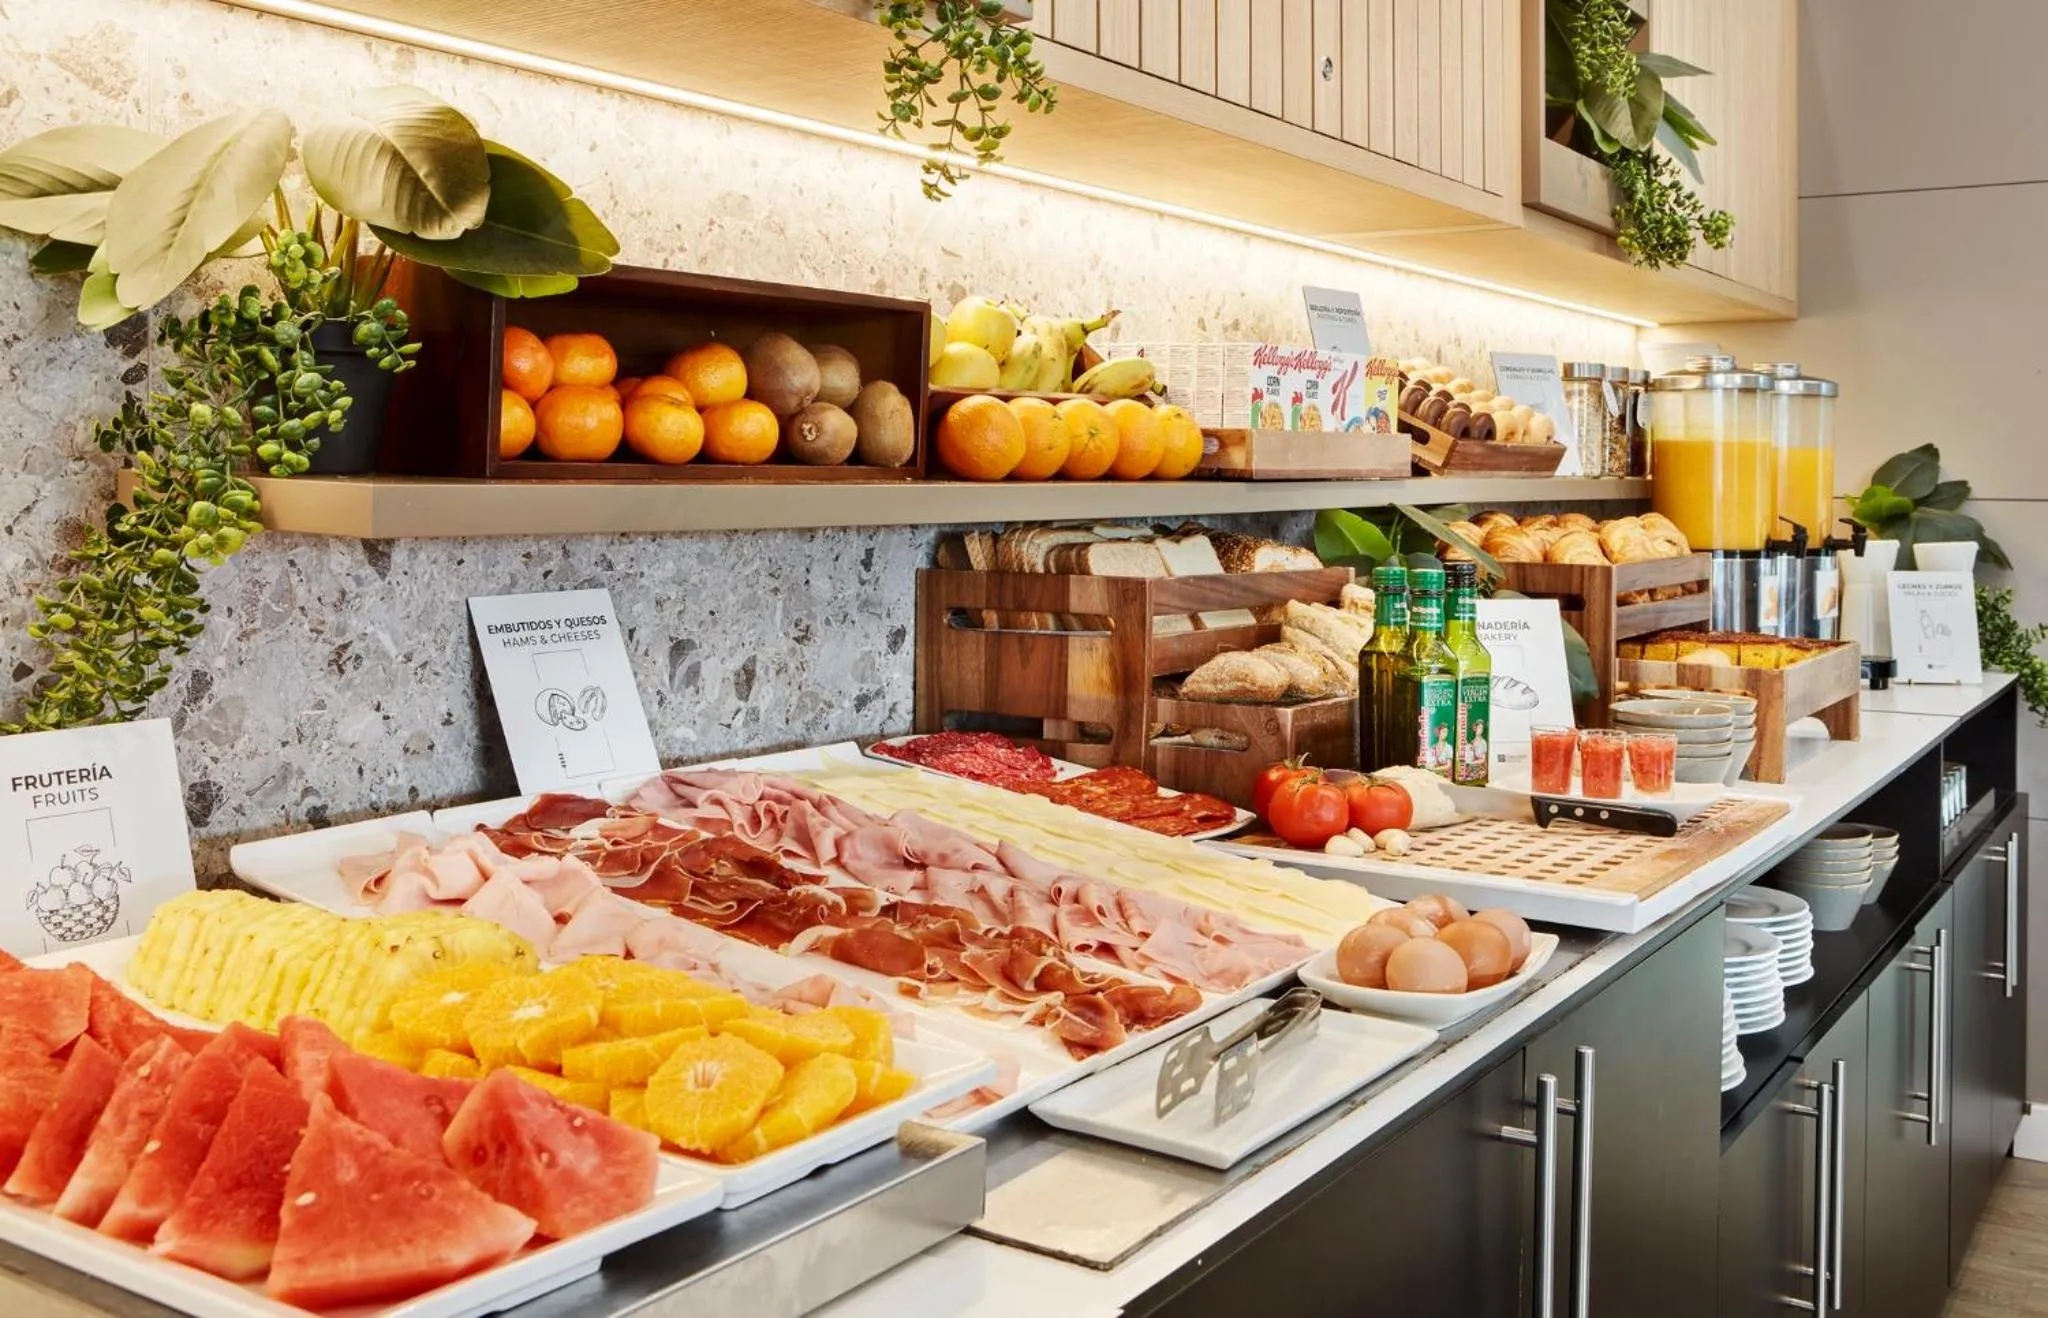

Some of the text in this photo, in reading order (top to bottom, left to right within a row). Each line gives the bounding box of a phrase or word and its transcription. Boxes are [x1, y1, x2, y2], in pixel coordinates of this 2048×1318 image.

[1253, 344, 1294, 376] Kellogg's
[1293, 349, 1331, 379] Kellogg's
[1266, 375, 1280, 387] CORN
[1306, 379, 1319, 390] CORN
[1331, 360, 1358, 421] K
[487, 615, 608, 634] EMBUTIDOS Y QUESOS
[1477, 618, 1531, 631] NADERÍA
[502, 629, 602, 648] HAMS & CHEESES
[11, 762, 113, 792] FRUTERÍA
[32, 786, 100, 809] FRUITS
